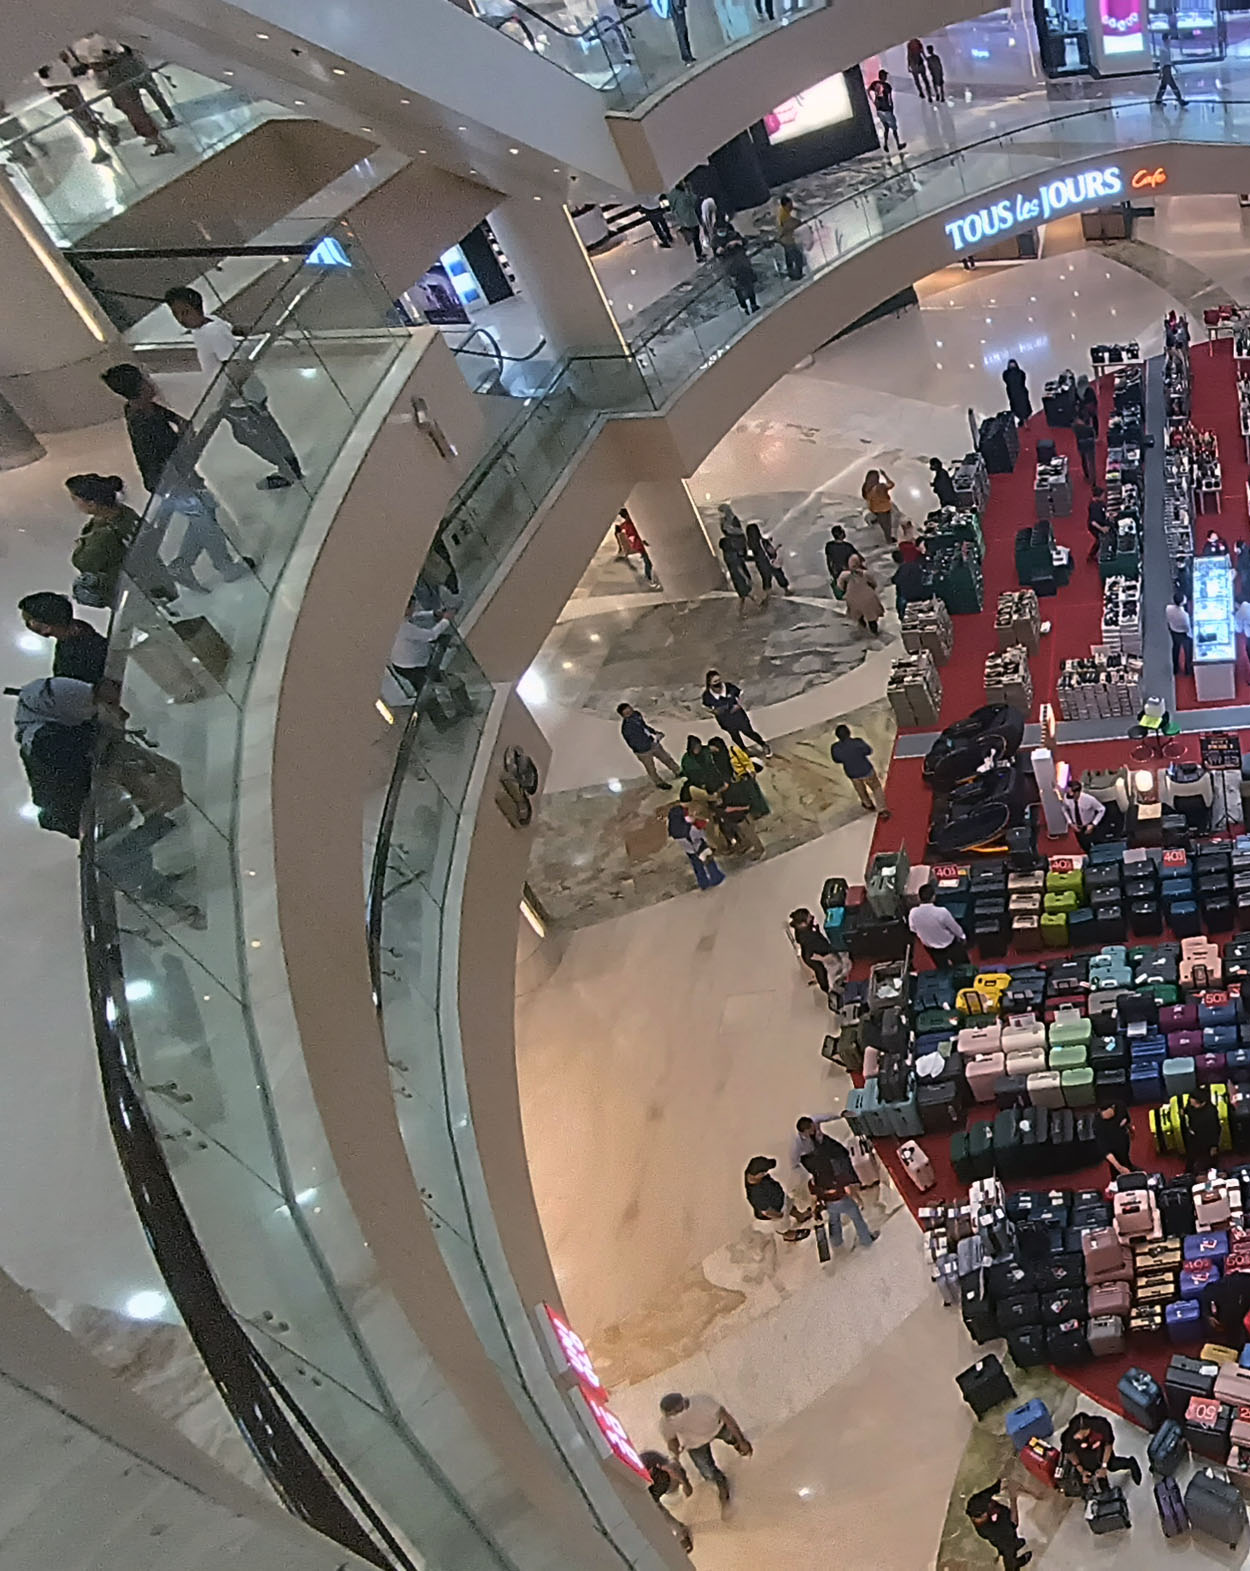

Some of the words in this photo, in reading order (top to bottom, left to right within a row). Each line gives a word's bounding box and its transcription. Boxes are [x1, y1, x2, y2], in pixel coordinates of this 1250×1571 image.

[945, 200, 1013, 250] TOUS
[1016, 193, 1039, 222] les
[1039, 166, 1122, 219] JOURS
